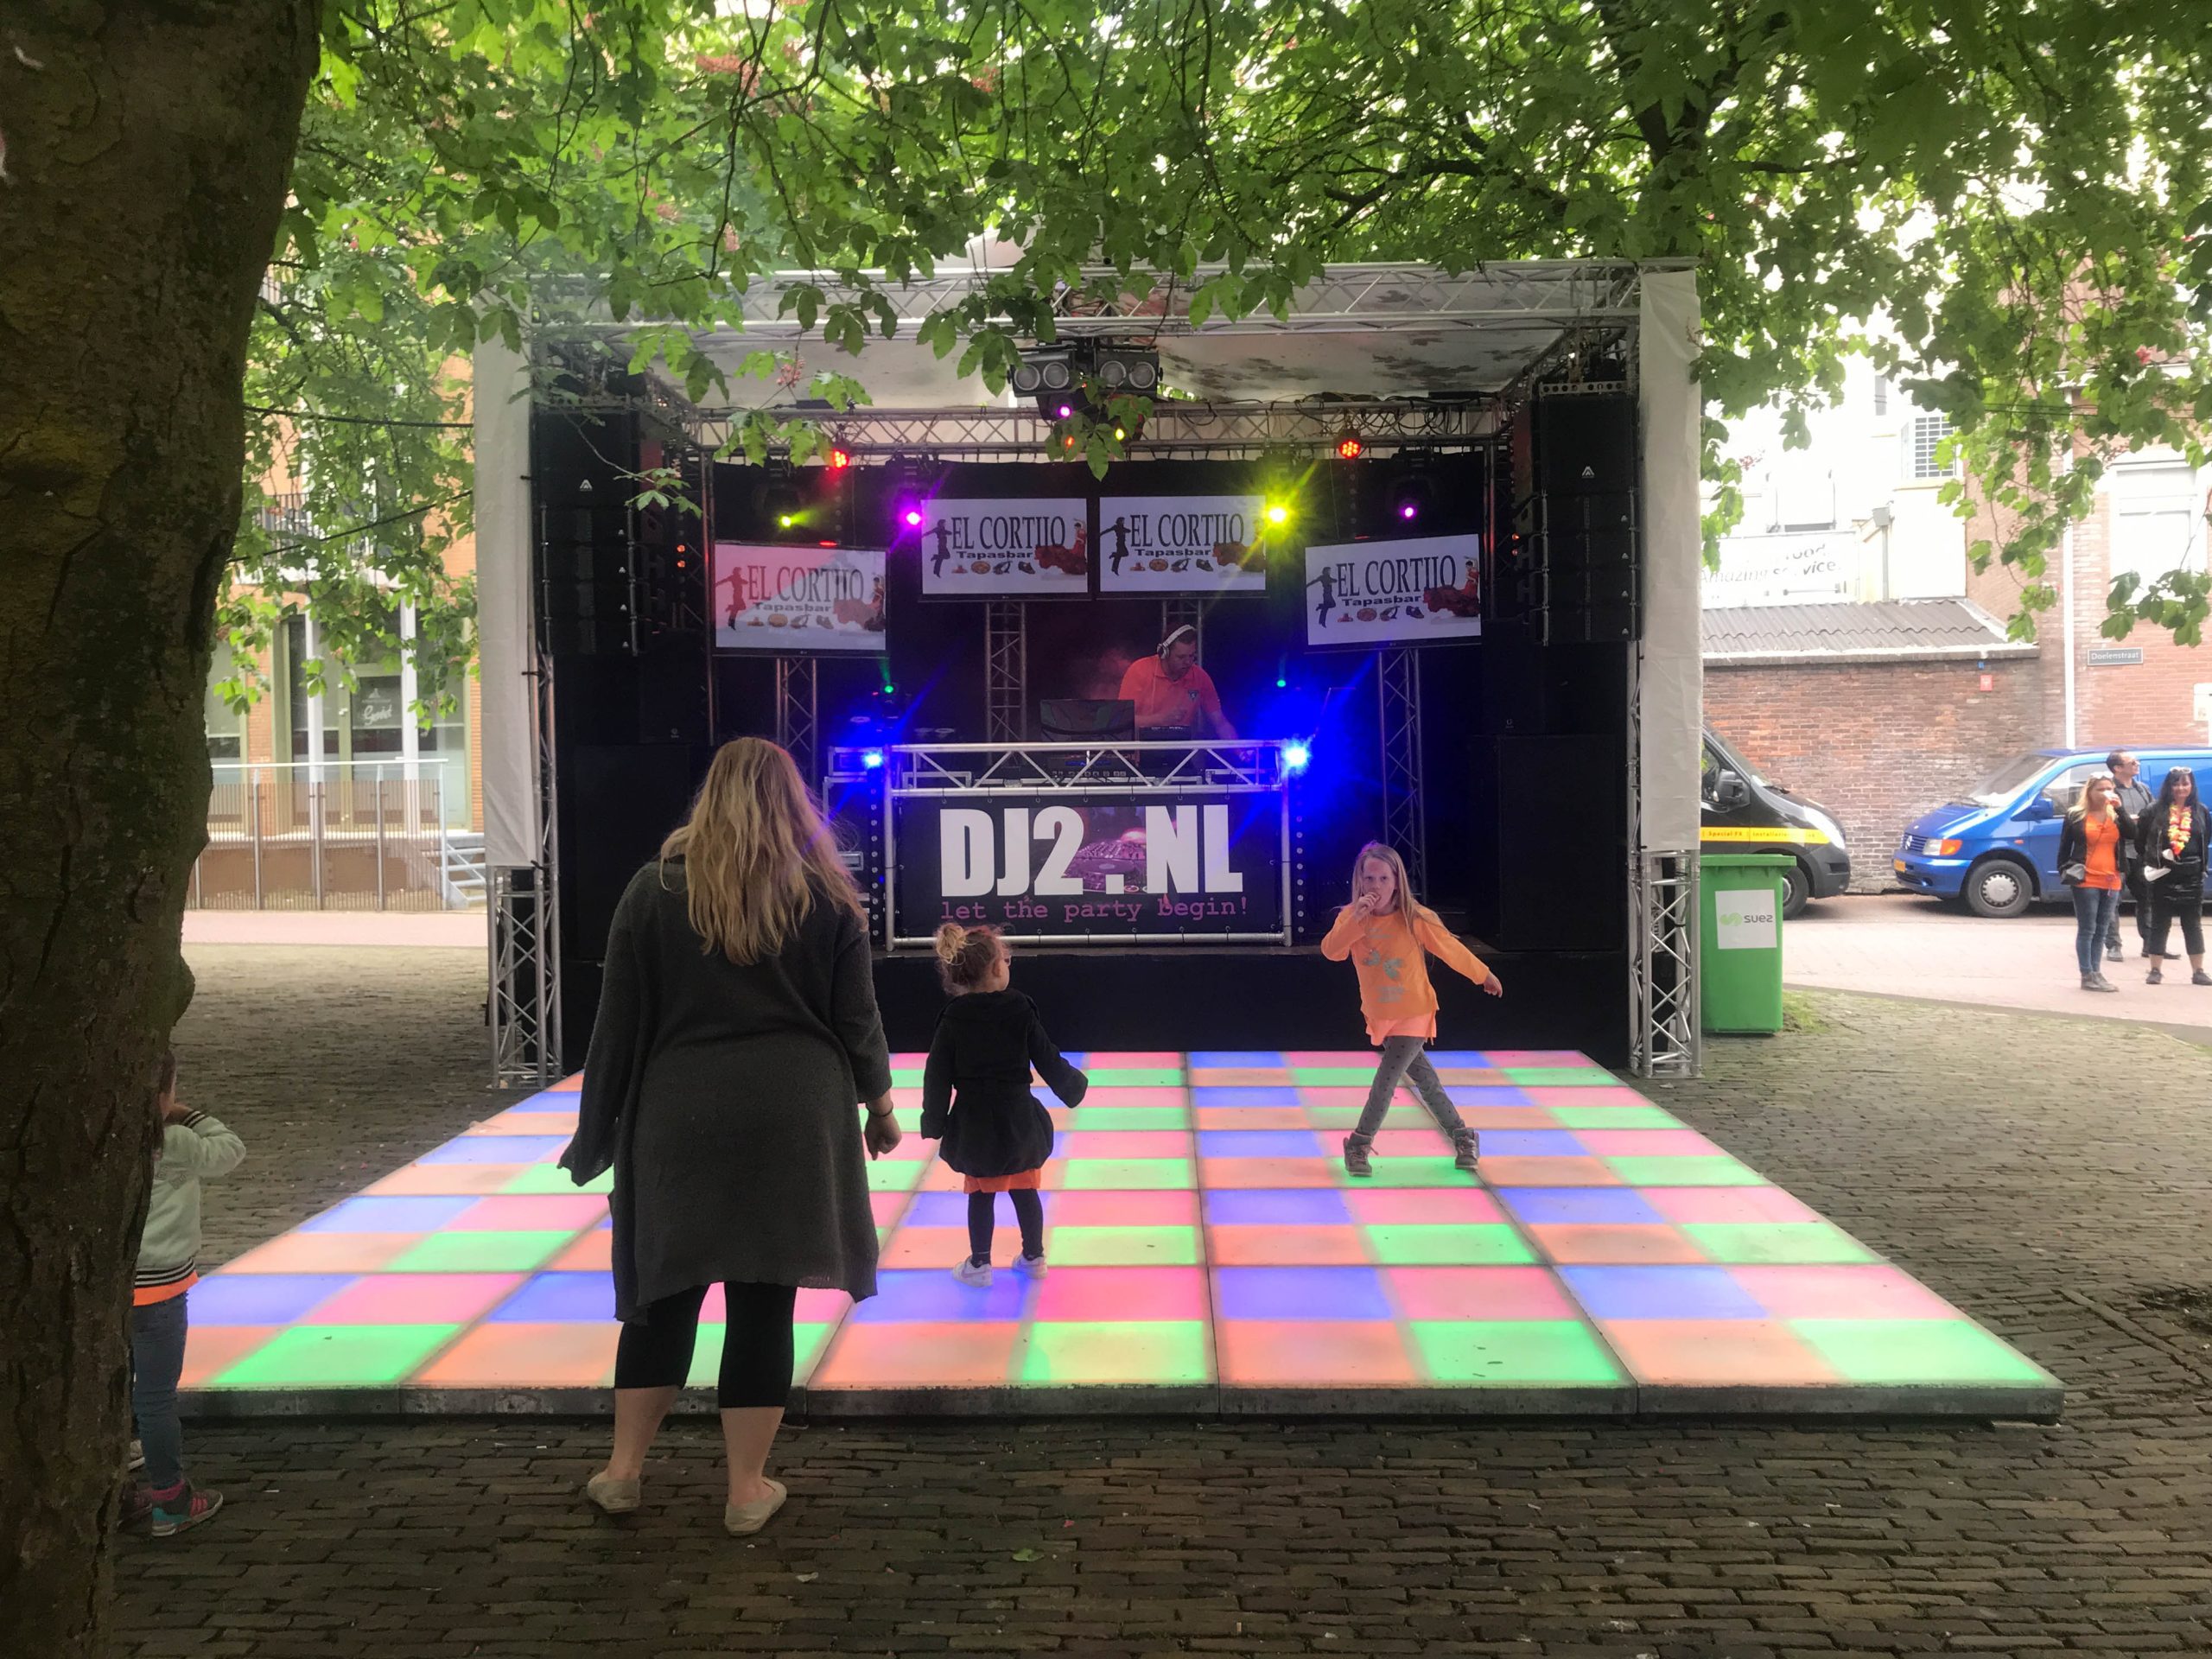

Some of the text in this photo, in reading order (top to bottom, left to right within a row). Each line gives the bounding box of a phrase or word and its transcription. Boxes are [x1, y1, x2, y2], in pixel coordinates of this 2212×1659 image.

[951, 517, 975, 550] EL
[1130, 514, 1153, 547] EL
[957, 551, 1033, 561] Tapasbar
[1135, 549, 1211, 558] Tapasbar
[747, 565, 772, 601] EL
[1336, 563, 1360, 597] EL
[753, 601, 832, 613] Tapasbar
[1341, 595, 1422, 607] Tapasbar
[2091, 652, 2139, 660] Doelenstraat
[940, 804, 1243, 897] DJ2.NL
[941, 896, 1248, 923] let the party begin!
[1744, 914, 1774, 924] suez
